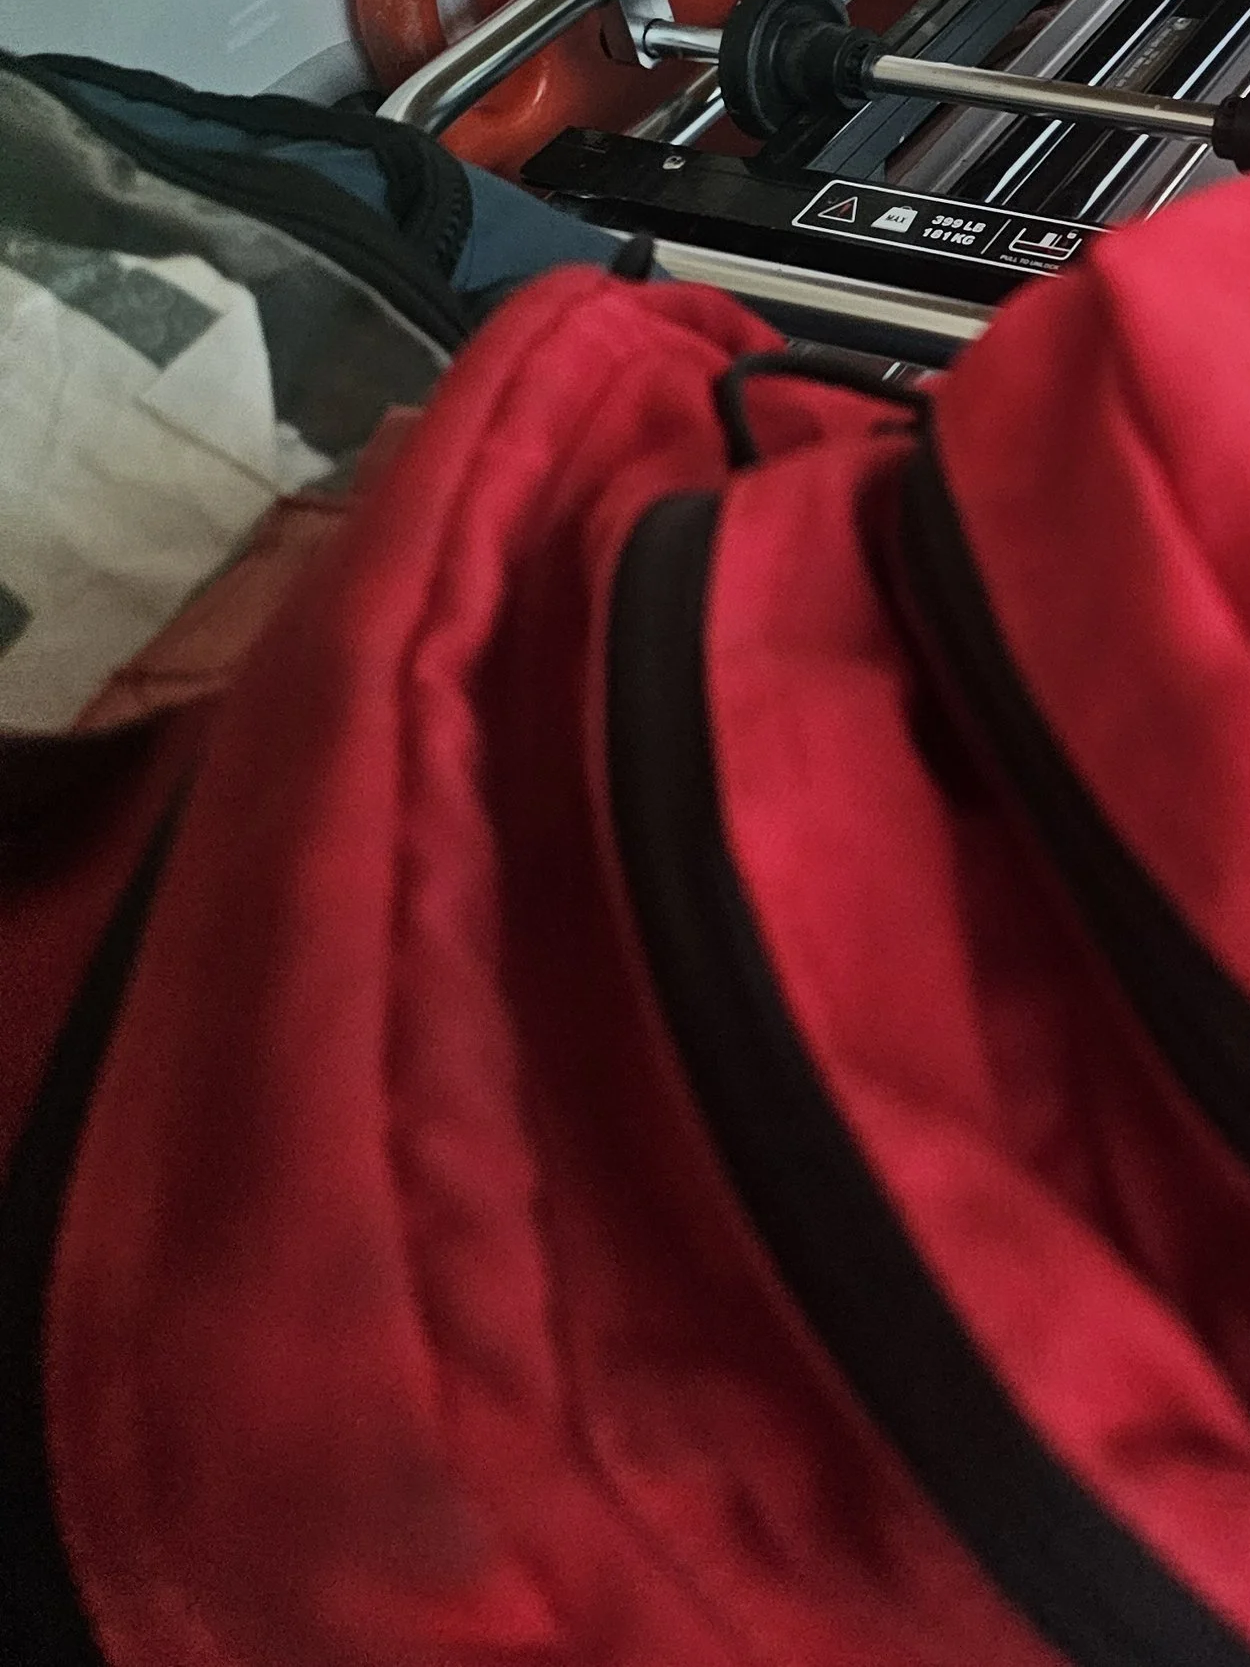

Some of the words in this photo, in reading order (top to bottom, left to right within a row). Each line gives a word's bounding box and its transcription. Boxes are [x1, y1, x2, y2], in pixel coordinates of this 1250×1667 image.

[885, 214, 908, 224] MAX
[999, 254, 1018, 263] PULL
[1019, 257, 1030, 265] TO
